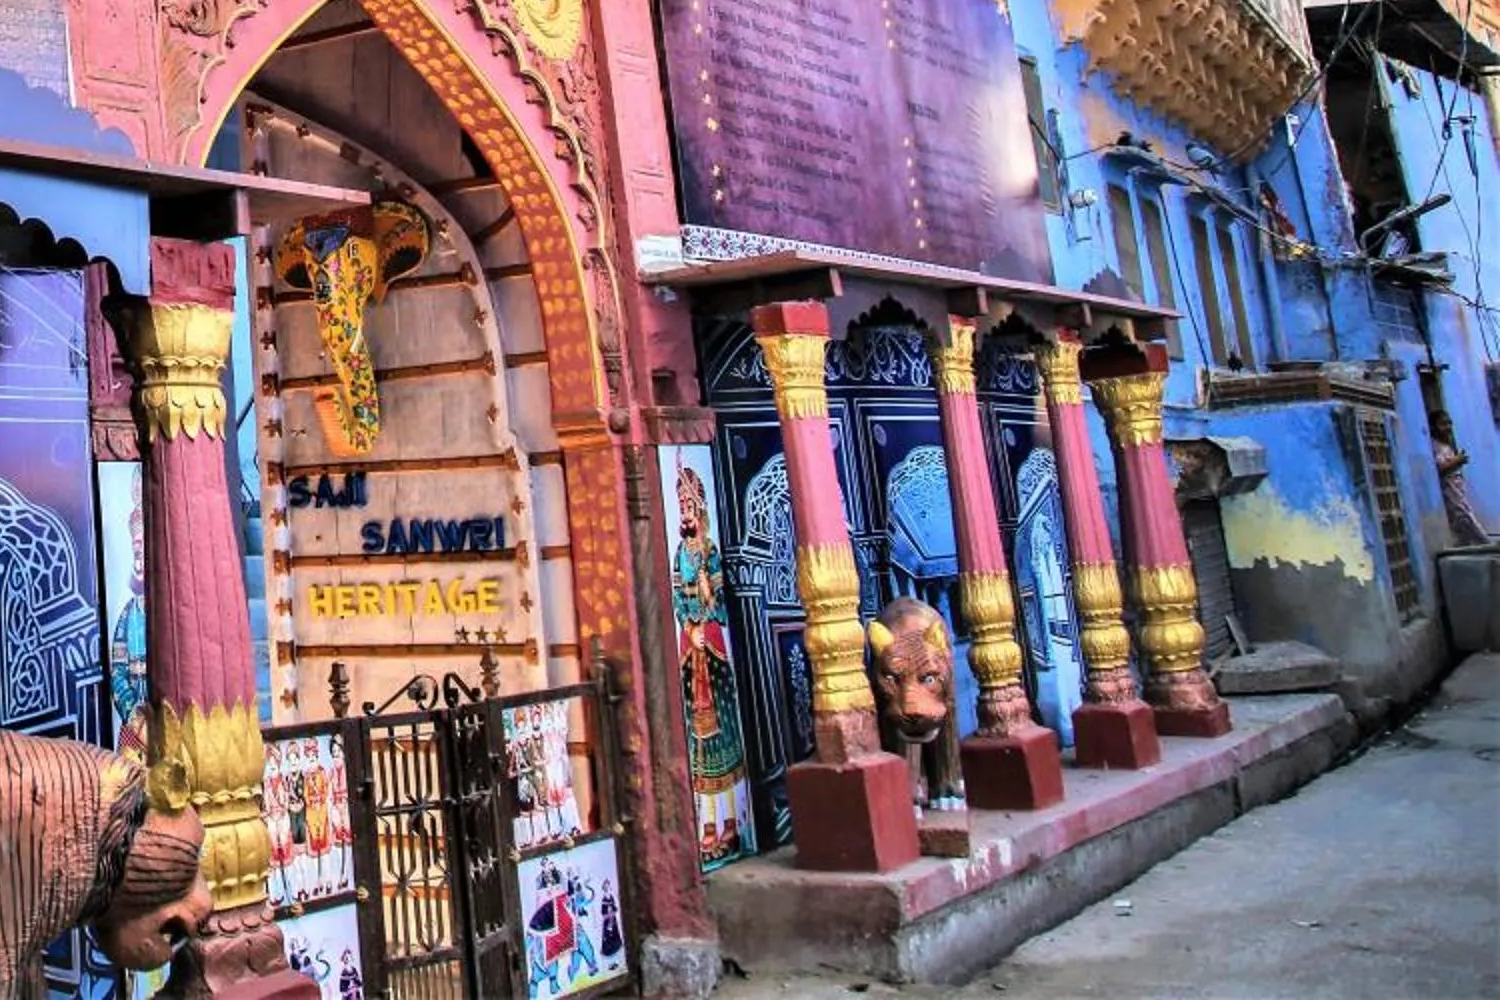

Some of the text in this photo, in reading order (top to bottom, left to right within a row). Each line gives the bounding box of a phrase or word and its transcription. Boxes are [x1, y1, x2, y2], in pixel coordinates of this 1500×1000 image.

[288, 471, 369, 509] SAJI
[361, 516, 506, 555] SANWRI
[307, 576, 502, 621] HERITAGE
